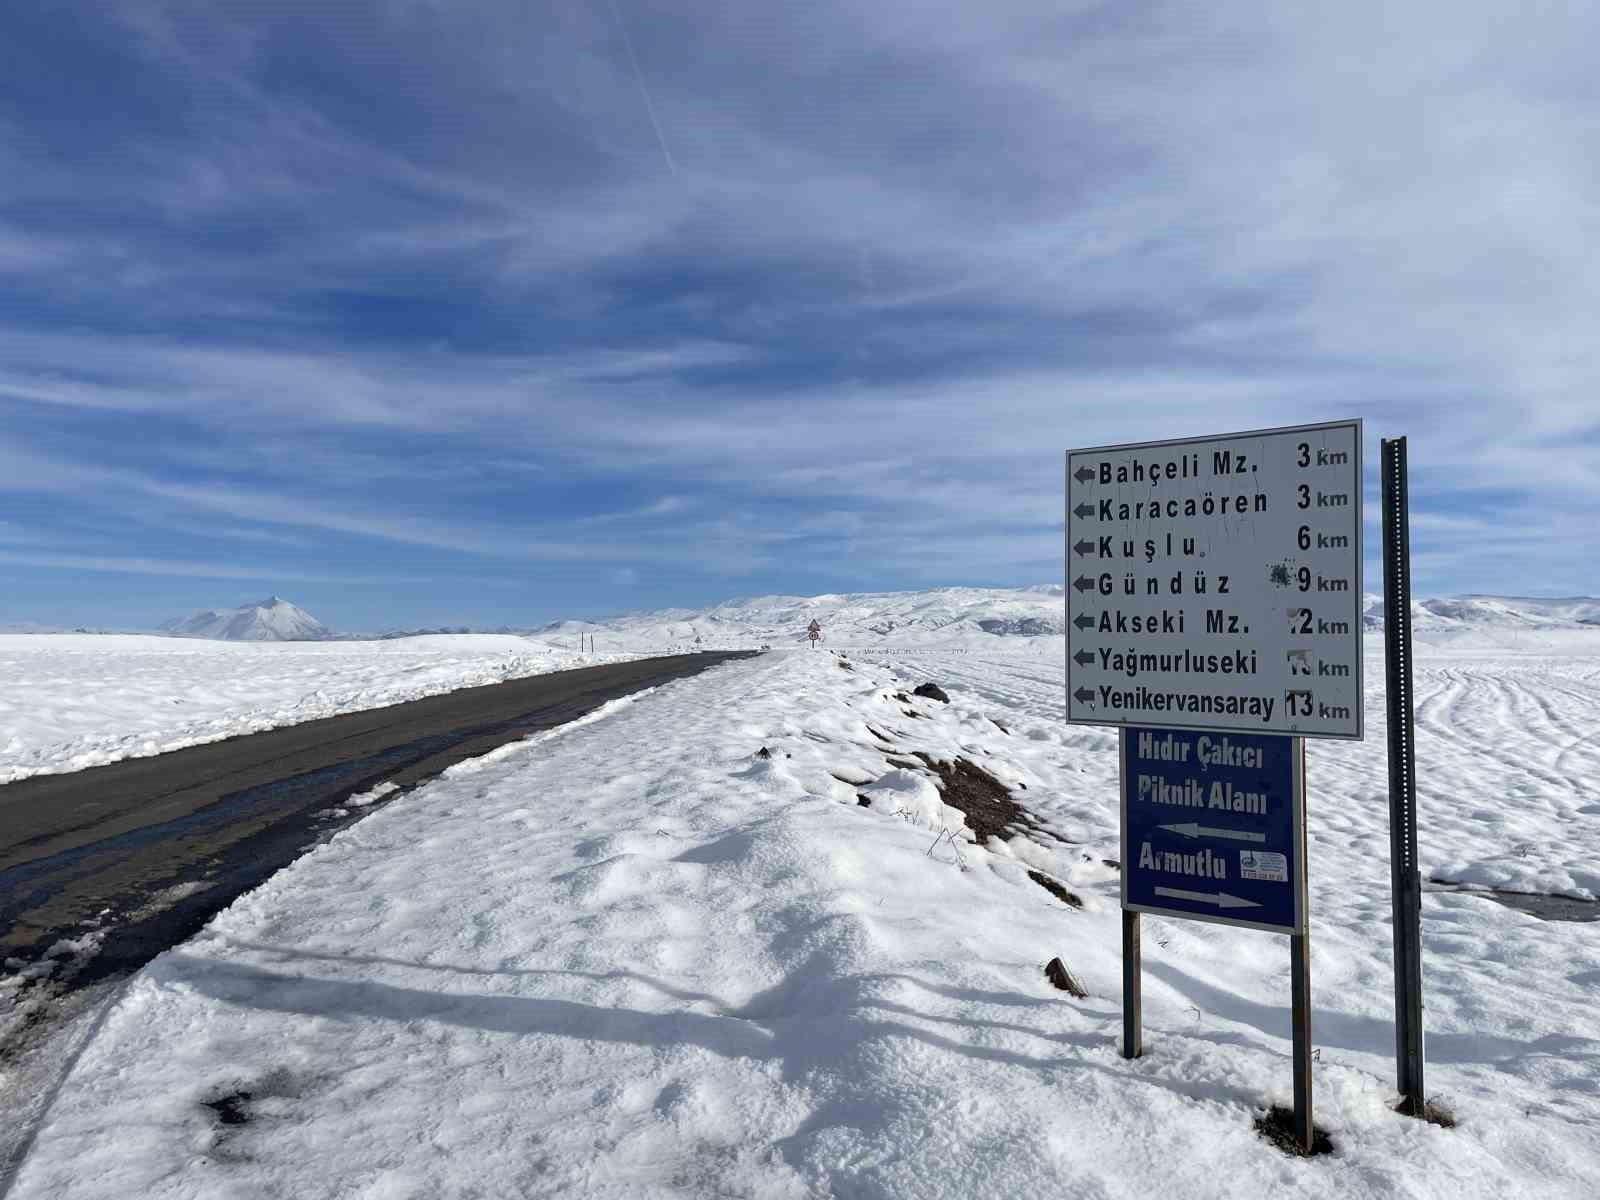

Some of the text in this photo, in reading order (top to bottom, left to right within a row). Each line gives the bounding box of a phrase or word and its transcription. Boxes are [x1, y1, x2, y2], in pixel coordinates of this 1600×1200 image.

[1099, 443, 1348, 486] Bahçeli Mz. 3 km
[1099, 484, 1348, 521] Karacaören 3 km
[1099, 525, 1348, 562] Kuşlu 6 km
[1099, 567, 1348, 595] Gündüz 9 km
[1099, 609, 1185, 633] Akseki
[1206, 609, 1249, 634] Mz.
[1318, 618, 1349, 634] km
[1099, 647, 1257, 677] Yağmurluseki
[1318, 659, 1349, 676] km
[1099, 685, 1350, 722] Yenikervansaray 13 km
[1138, 732, 1263, 772] Hıdır Çakıcı
[1138, 775, 1267, 815] Piknik Alanı
[1139, 841, 1227, 880] Armutlu
